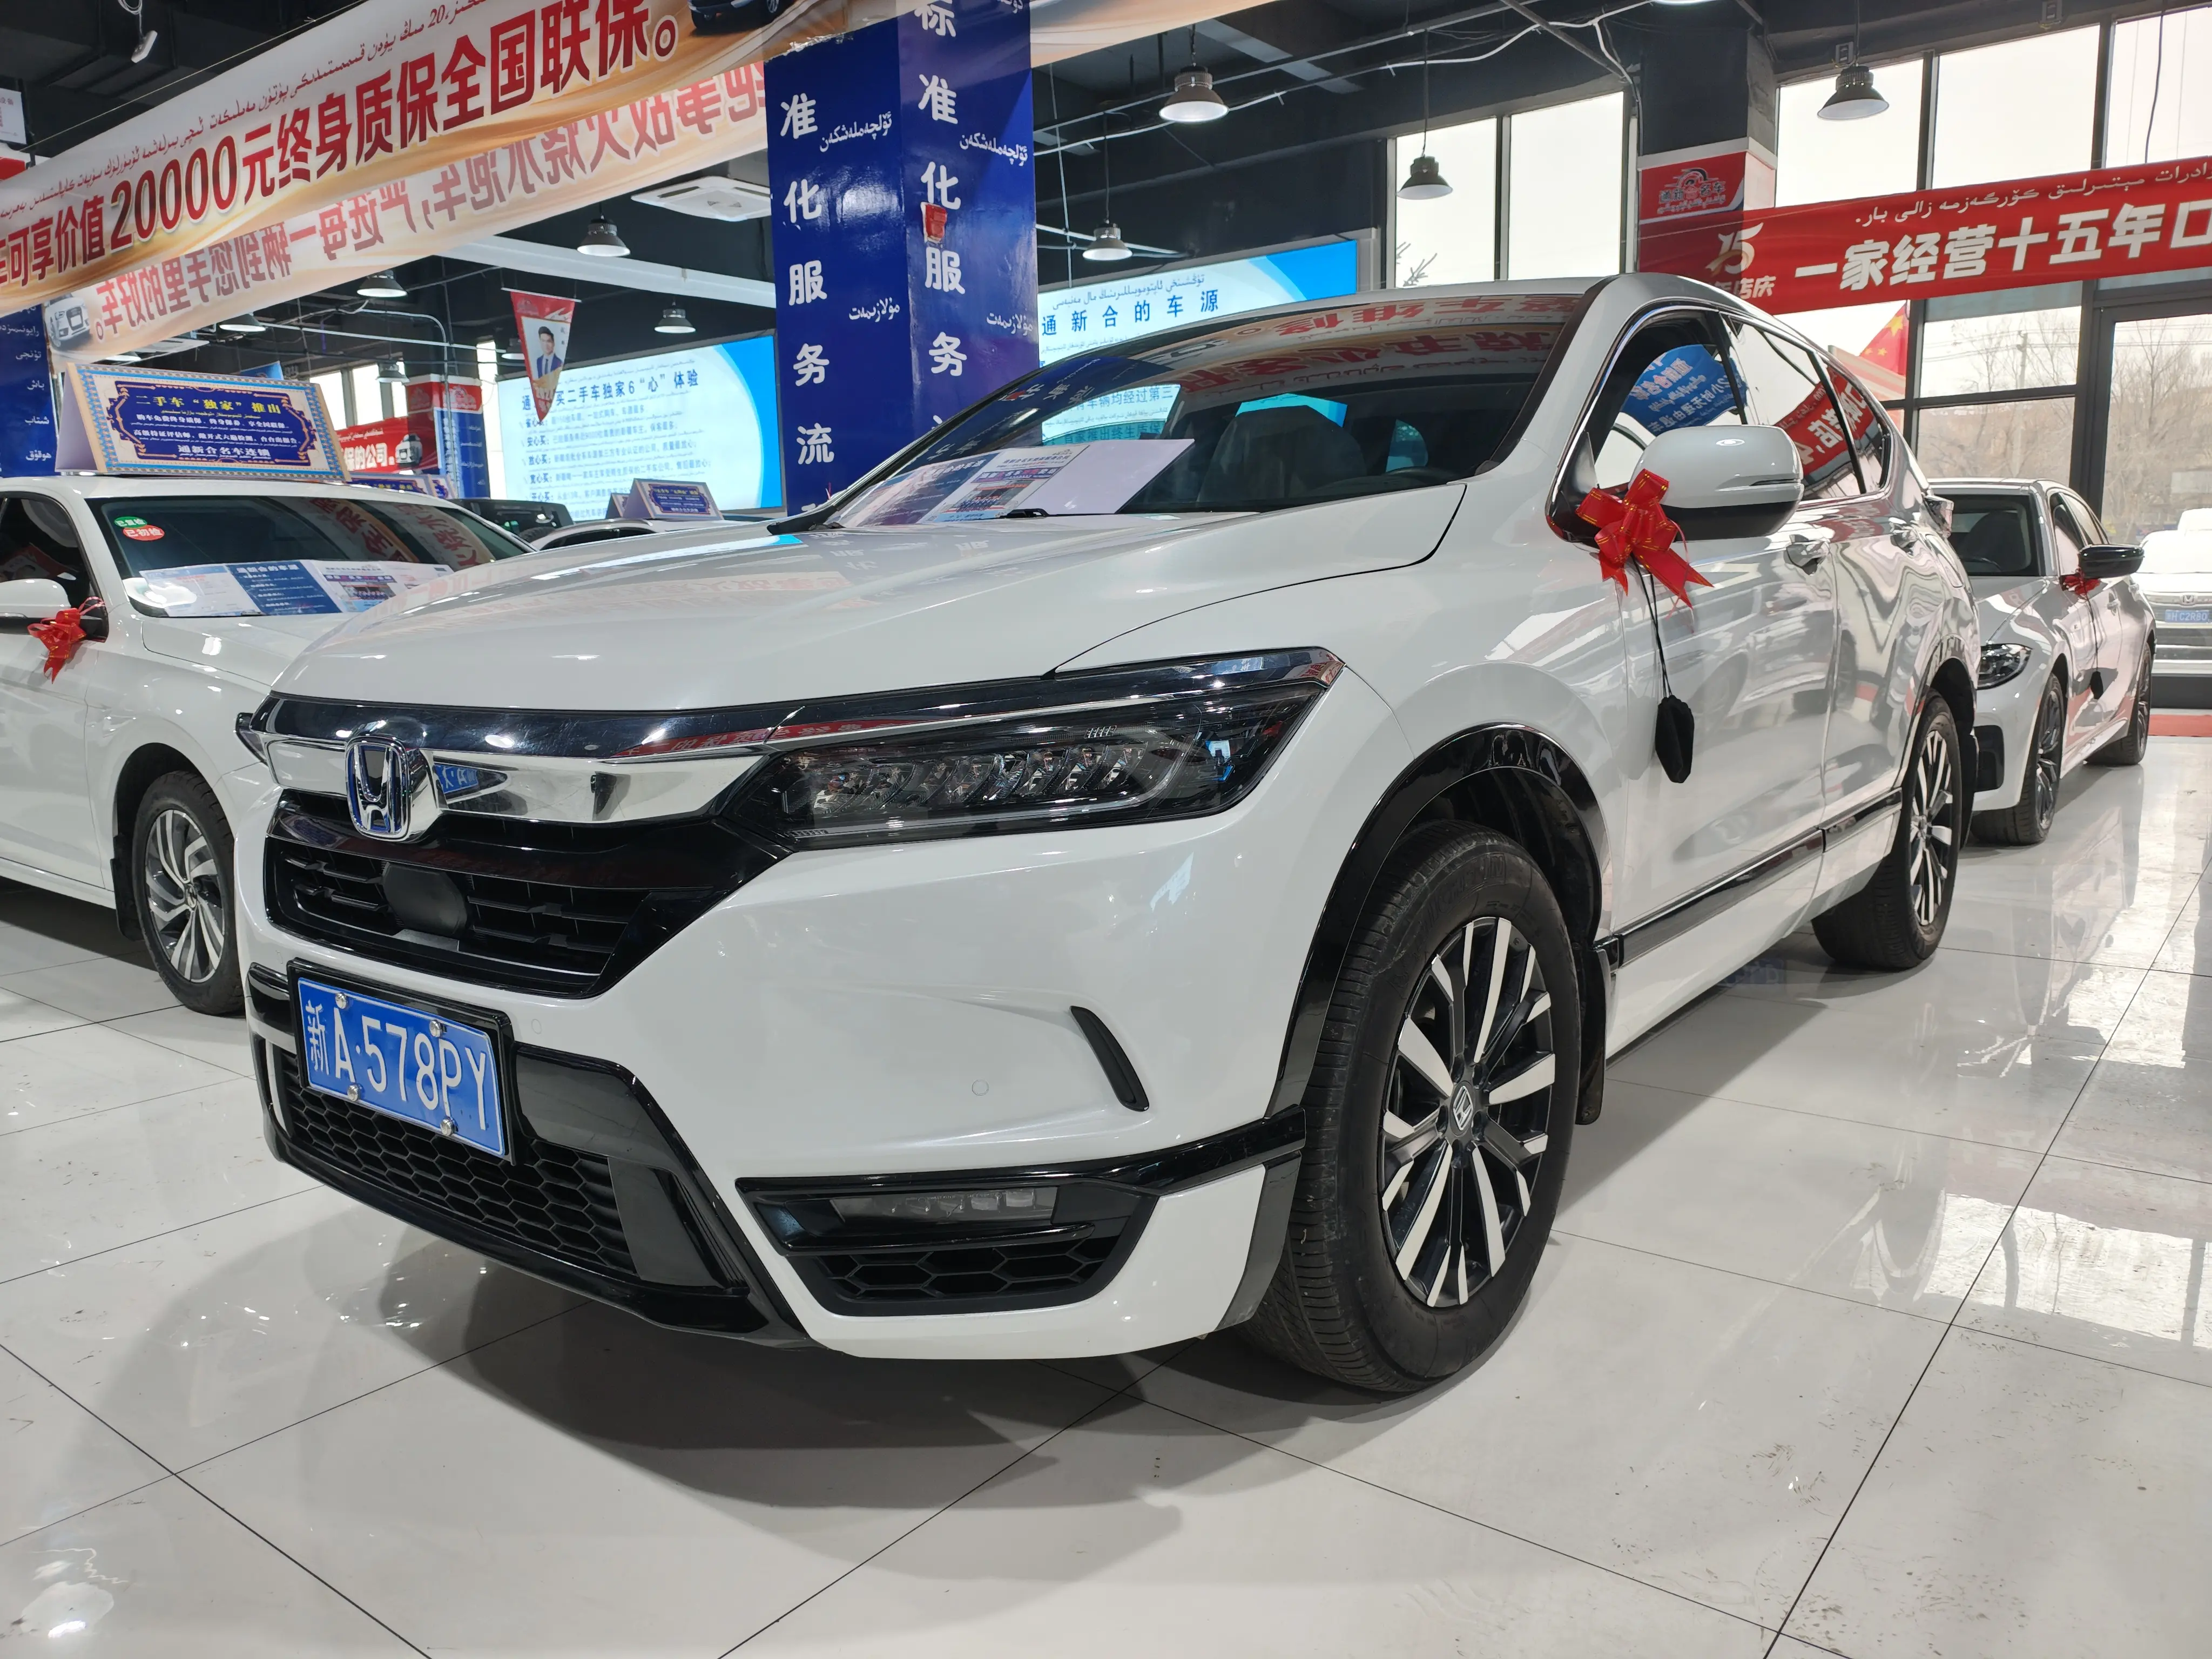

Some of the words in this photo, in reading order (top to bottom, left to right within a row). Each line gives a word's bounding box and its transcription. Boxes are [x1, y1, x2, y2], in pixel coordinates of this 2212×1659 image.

[914, 0, 968, 430] 标准化服务
